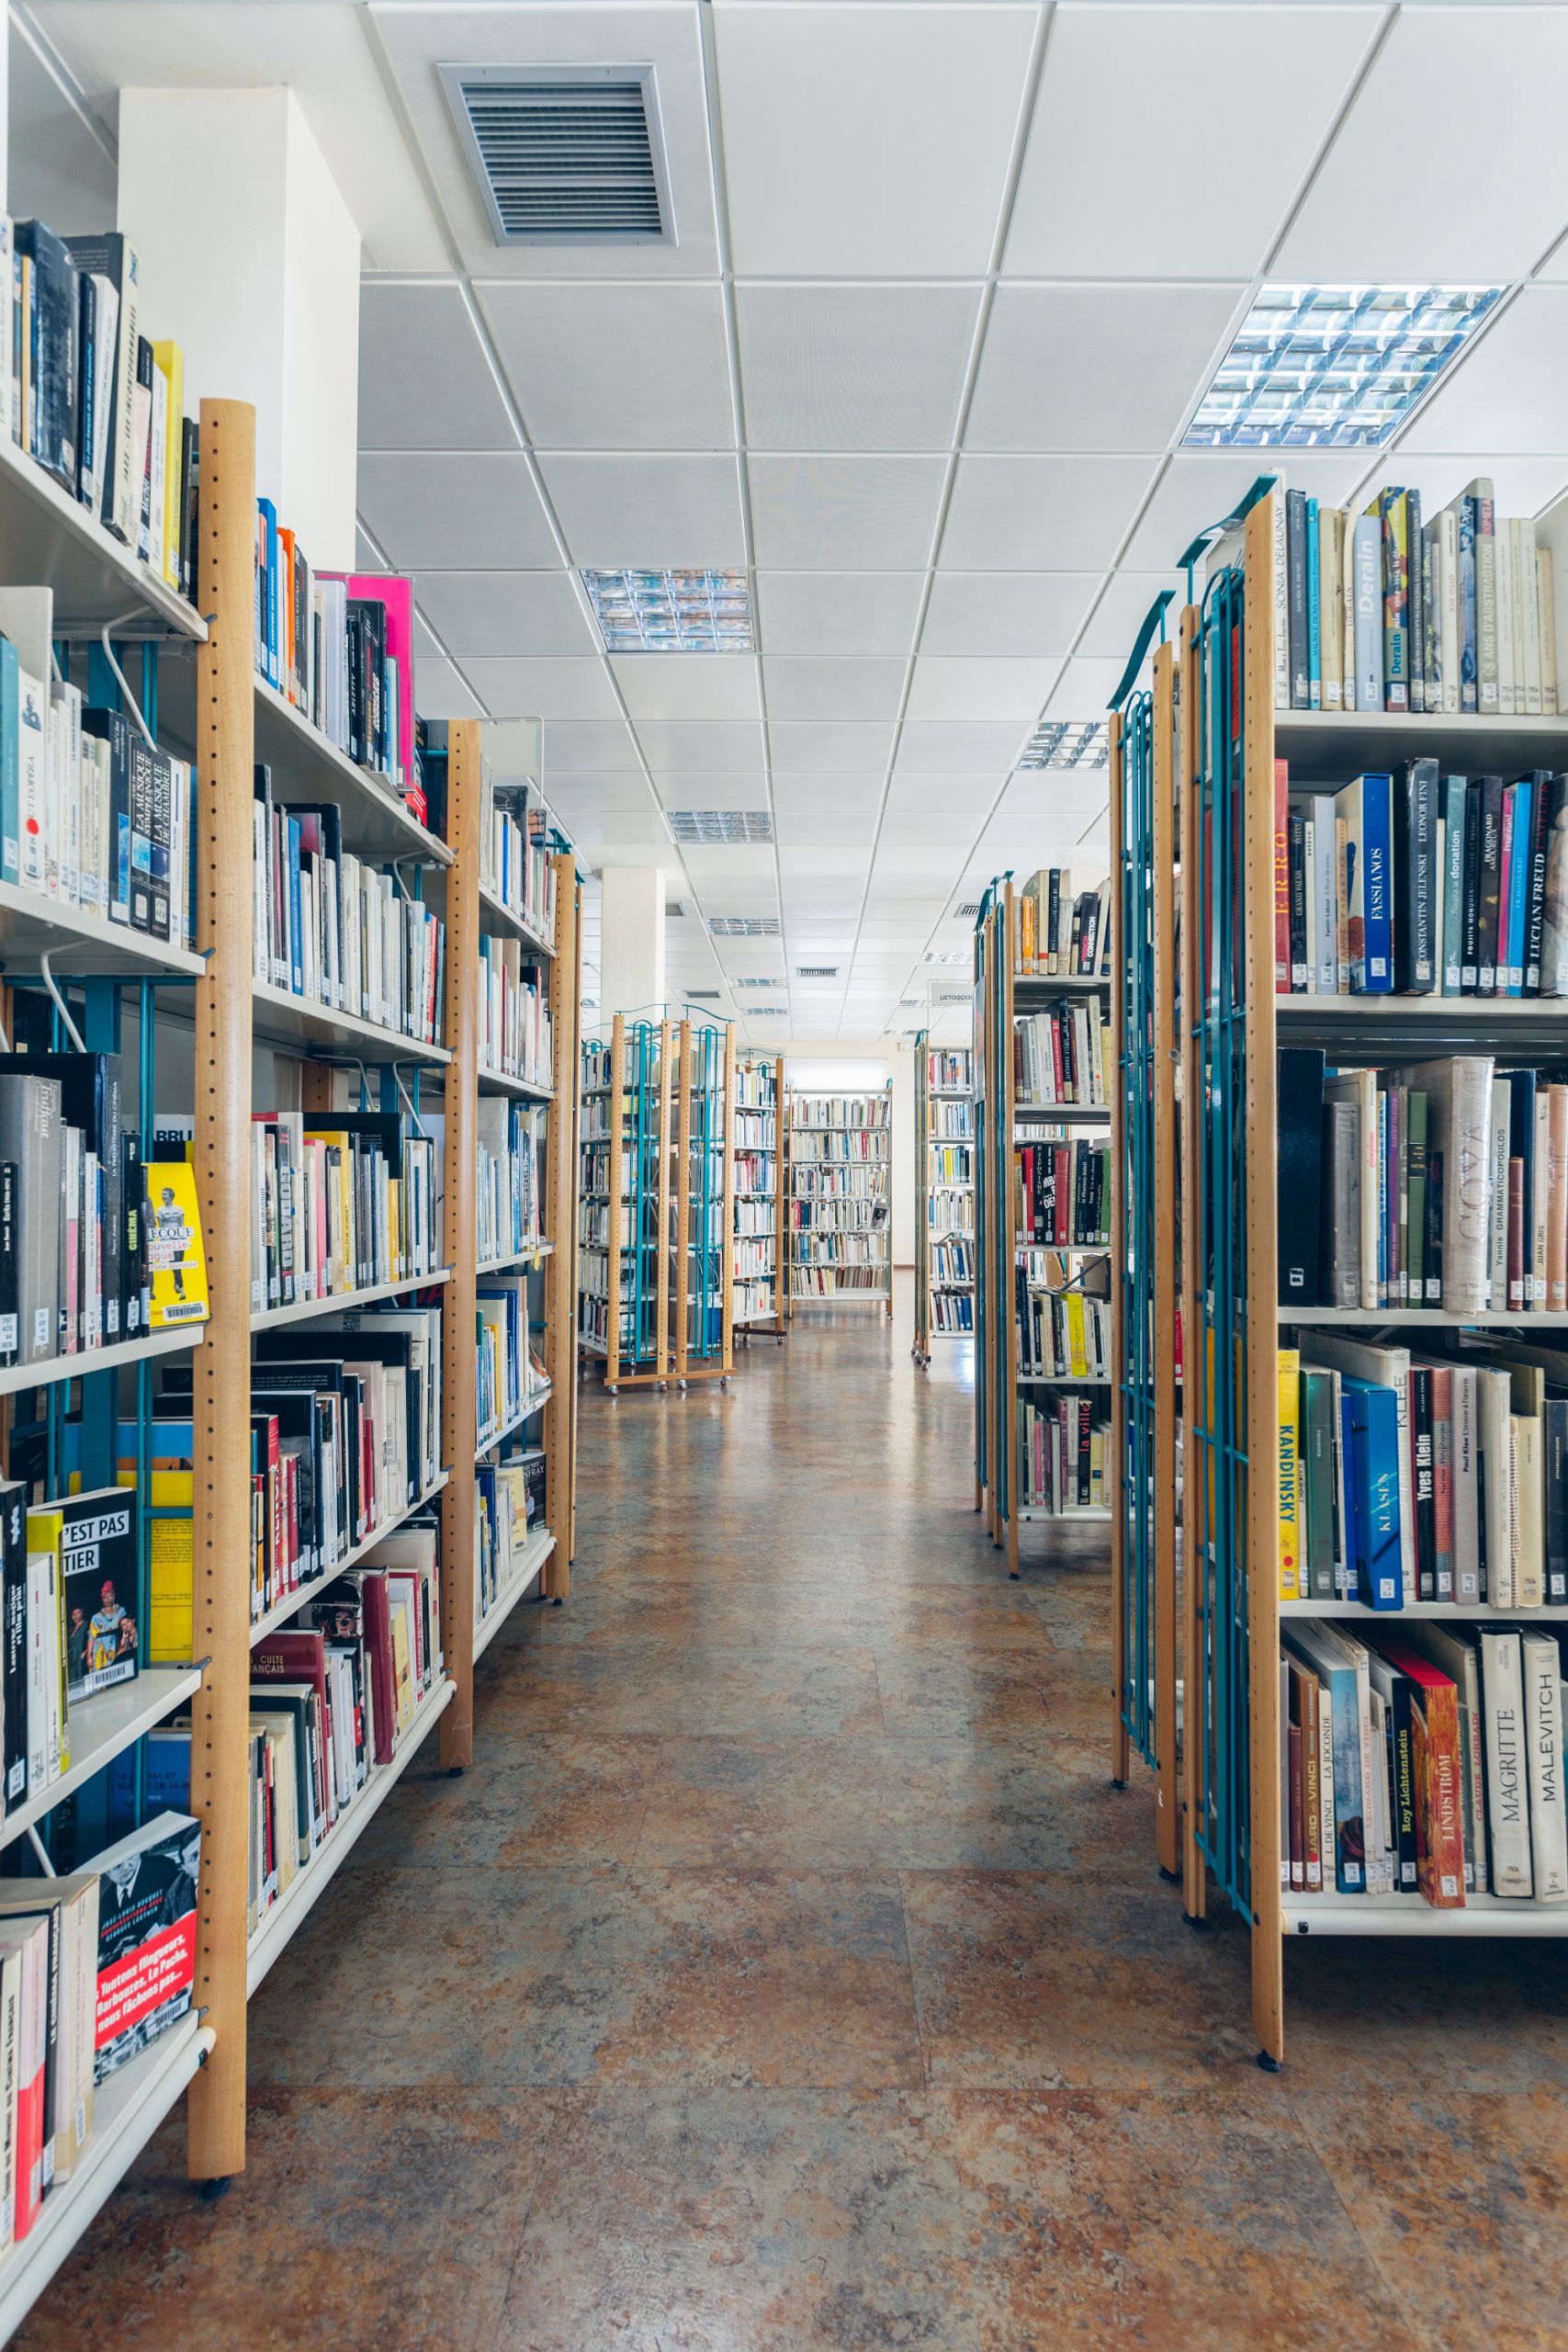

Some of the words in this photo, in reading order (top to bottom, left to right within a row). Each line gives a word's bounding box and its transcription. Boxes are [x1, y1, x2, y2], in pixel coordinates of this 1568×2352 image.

[141, 473, 151, 515] Michel
[1276, 504, 1286, 566] DELAUNAY
[1482, 498, 1492, 537] DOMELA
[1276, 571, 1286, 610] SONIA
[1358, 539, 1373, 613] Derain
[1481, 543, 1494, 631] D'ABSTRACTION
[1345, 587, 1353, 627] DERAIN
[1390, 633, 1402, 675] Derain
[1483, 634, 1495, 659] ANS
[1485, 662, 1495, 676] 65
[135, 750, 146, 808] MUSIQUE
[143, 755, 152, 836] SYMPHONIQUE
[152, 763, 163, 821] MUSIQUE
[161, 767, 170, 828] CHAMBRE
[1417, 780, 1427, 802] FINI
[136, 811, 145, 831] LA
[153, 823, 163, 842] LA
[162, 830, 170, 845] DE
[1417, 803, 1427, 842] LEONOR
[1503, 814, 1512, 852] Fragonard
[1535, 784, 1550, 850] L'ATELIER
[1450, 830, 1460, 879] donation
[1489, 828, 1497, 871] AMOUREUX
[1371, 848, 1382, 920] FASSIANOS
[1417, 854, 1428, 899] JELENSKI
[1450, 880, 1459, 888] la
[1532, 853, 1545, 901] FREUD
[1086, 916, 1096, 958] CONNECTION
[1417, 901, 1427, 964] CONSTANTIN
[1529, 903, 1541, 957] LUCIAN
[111, 1112, 118, 1123] DU
[1458, 1126, 1486, 1243] GOYA
[1495, 1129, 1505, 1230] GRAMMATICOPOULOS
[128, 1209, 137, 1251] CINÉMA
[149, 1227, 193, 1239] ECQUE
[1496, 1236, 1505, 1266] Yannis
[1537, 1244, 1545, 1266] JUAN
[1078, 1404, 1089, 1434] ville
[1393, 1374, 1407, 1428] KLEE
[1078, 1439, 1089, 1453] la
[1416, 1434, 1431, 1466] Klein
[1280, 1425, 1295, 1522] KANDINSKY
[1417, 1471, 1433, 1501] Yves
[1378, 1472, 1391, 1532] KLASEN
[99, 1515, 125, 1536] PAS
[65, 1549, 95, 1573] TIER
[250, 1665, 285, 1676] ANÇAIS
[260, 1655, 284, 1664] CULTE
[1322, 1715, 1333, 1763] JOCONDE
[1362, 1715, 1371, 1749] VINCI
[1472, 1713, 1482, 1766] LORRAIN
[1540, 1673, 1556, 1802] MALEVITCH
[1307, 1759, 1317, 1801] VINCI
[1323, 1765, 1332, 1779] LA
[1339, 1764, 1349, 1792] Sainte
[1363, 1753, 1371, 1769] DE
[1399, 1729, 1411, 1806] Lichtenstein
[1497, 1709, 1520, 1823] MAGRITTE
[1324, 1799, 1334, 1829] VINCI
[1364, 1771, 1372, 1829] LEONARD
[1435, 1754, 1455, 1841] LINDSTRÖM
[1474, 1773, 1483, 1821] CLAUDE
[1324, 1830, 1334, 1844] DE
[1401, 1809, 1413, 1833] Roy
[102, 1904, 136, 1930] JOSÉ-LOUIS
[137, 1888, 164, 1909] BOCQUET
[106, 1922, 131, 1942] GEORGES
[132, 1905, 159, 1928] LAUTNER
[144, 1896, 164, 1912] AVEC
[51, 1906, 61, 1972] FRANÇAIS
[96, 1976, 147, 2017] Barbouzes,
[148, 1967, 159, 1982] Le
[159, 1949, 188, 1974] Pacha,
[100, 1963, 138, 1997] Tontons
[139, 1934, 187, 1974] flingueurs,
[97, 2010, 121, 2034] nous
[123, 1986, 158, 2017] fâchons
[159, 1971, 183, 1996] pas...
[50, 2026, 57, 2043] LE
